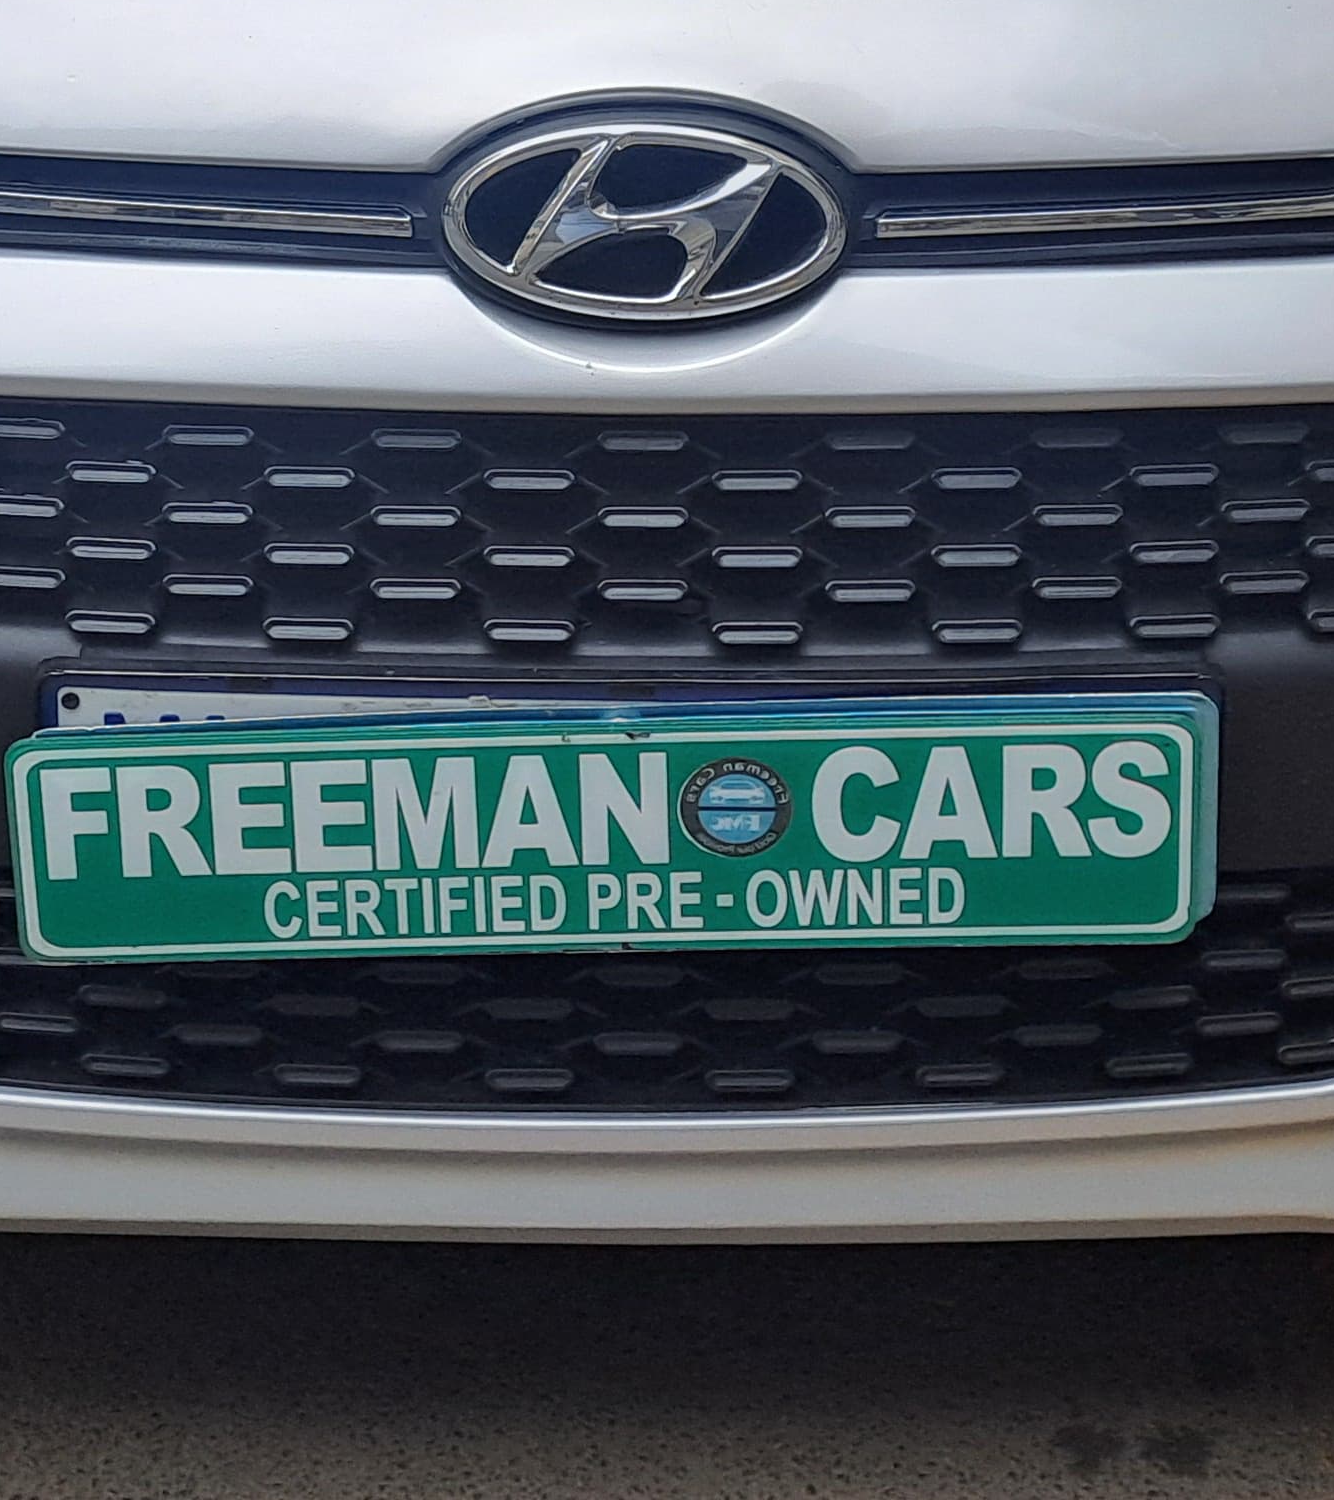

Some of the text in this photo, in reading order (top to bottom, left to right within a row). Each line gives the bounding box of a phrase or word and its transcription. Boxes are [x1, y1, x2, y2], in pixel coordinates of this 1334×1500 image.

[38, 739, 1172, 881] FREEMAN CARS
[264, 871, 568, 940] CERTIFIED
[587, 870, 705, 930] PRE
[746, 867, 966, 928] OWNED
